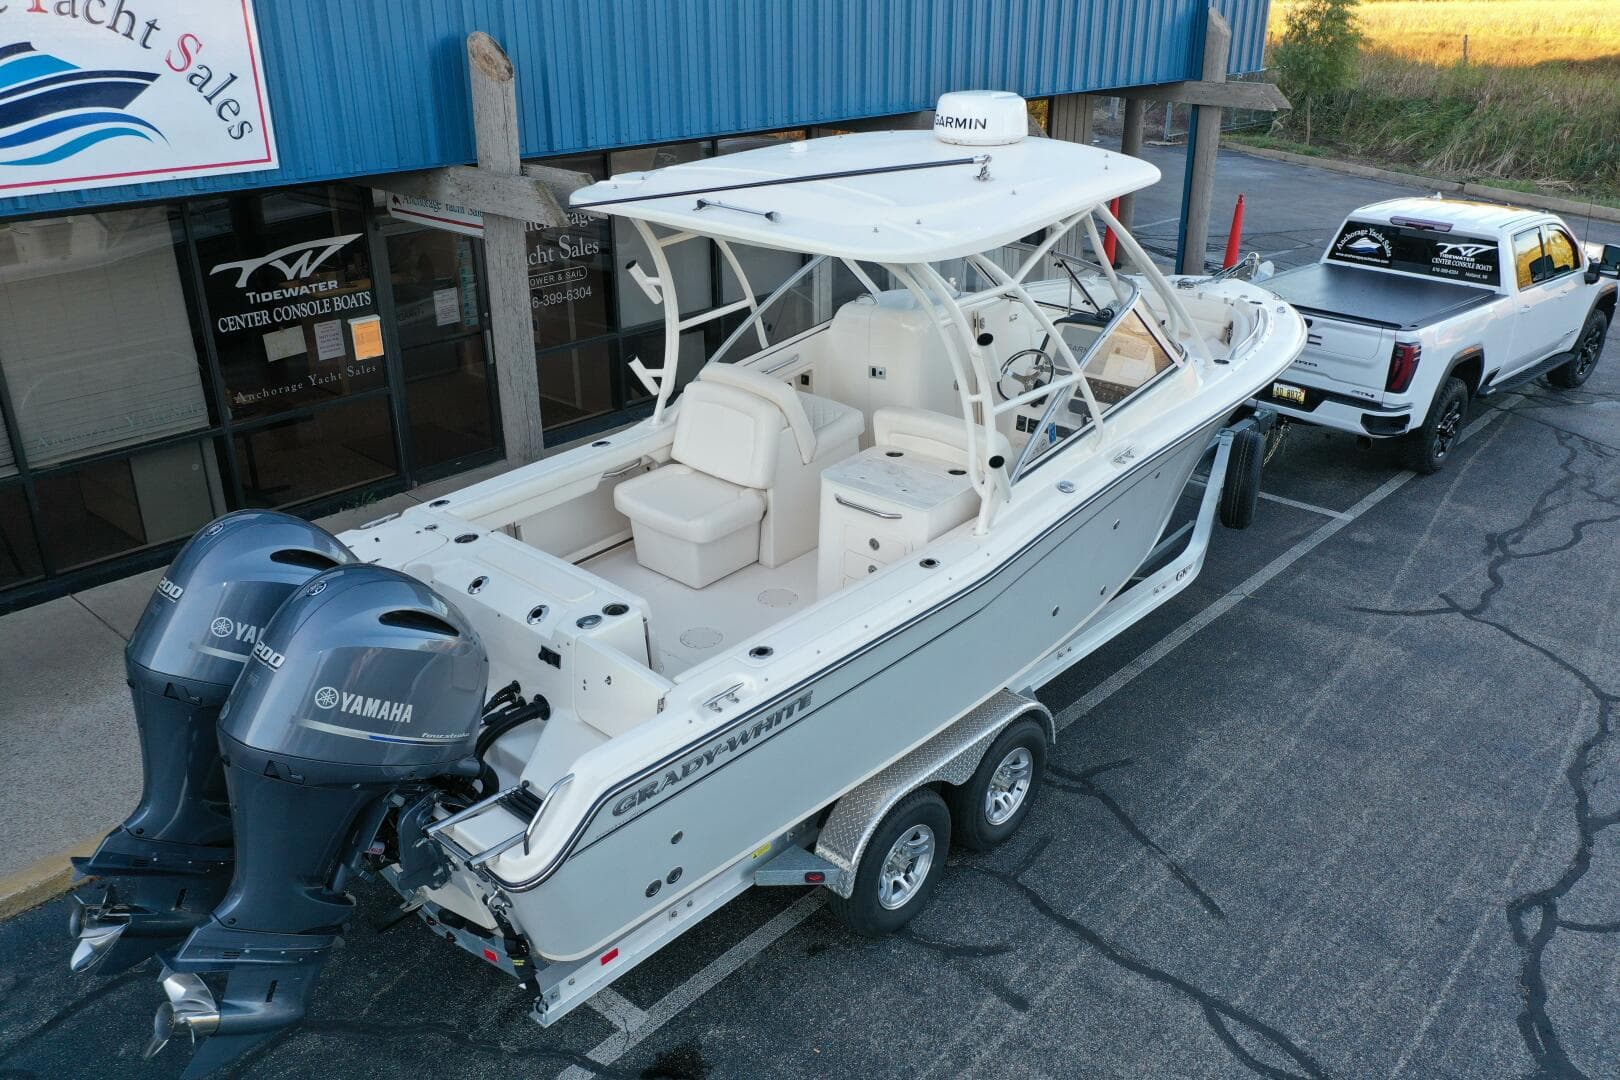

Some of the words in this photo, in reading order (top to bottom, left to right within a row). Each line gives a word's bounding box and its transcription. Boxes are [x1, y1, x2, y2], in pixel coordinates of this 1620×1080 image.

[165, 33, 254, 141] Sales
[935, 113, 987, 130] GARMIN
[558, 235, 599, 260] Sales
[1431, 257, 1452, 266] CENTER
[1451, 260, 1475, 269] CONSOLE
[1475, 264, 1493, 272] BOATS
[529, 275, 556, 287] OWER
[565, 269, 584, 279] SAIL
[246, 280, 339, 304] TIDEWATER
[531, 285, 592, 309] 6-399-6304
[217, 309, 272, 333] CENTER
[273, 299, 332, 322] CONSOLE
[334, 291, 372, 312] BOATS
[234, 381, 303, 404] Anchorage
[308, 372, 342, 387] Yacht
[347, 365, 377, 378] Sales
[158, 576, 184, 599] 200
[253, 640, 286, 669] 200
[340, 692, 414, 724] YAMAHA
[611, 690, 814, 817] GRADY-WHITE
